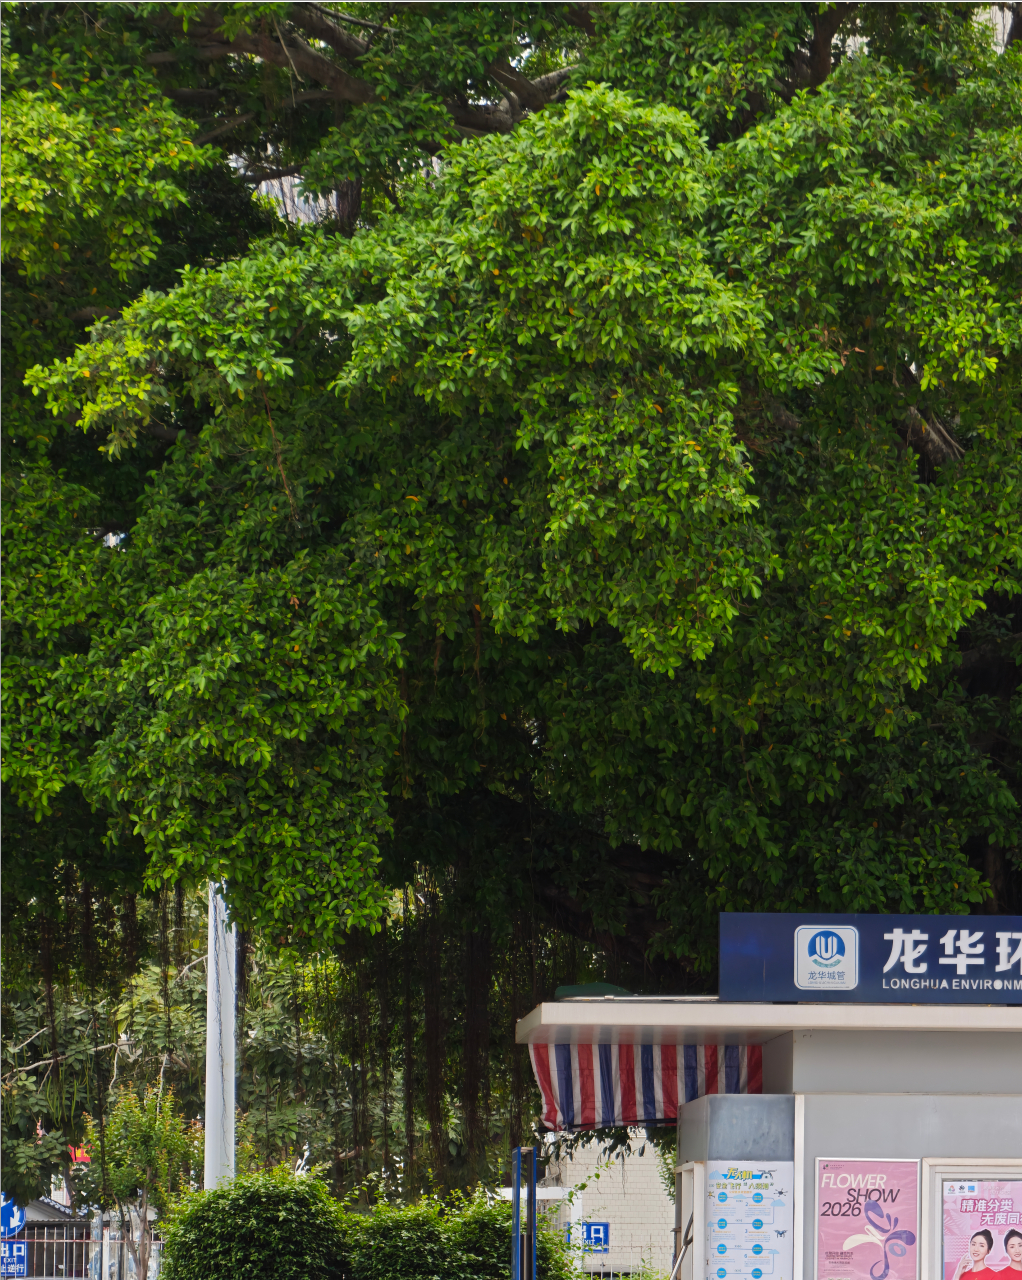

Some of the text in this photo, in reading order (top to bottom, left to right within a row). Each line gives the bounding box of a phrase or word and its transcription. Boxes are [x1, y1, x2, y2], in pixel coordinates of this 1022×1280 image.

[807, 970, 846, 981] 龙华城管
[882, 978, 949, 990] LONGHUA
[726, 1167, 753, 1181] 无人机
[821, 1173, 887, 1189] FLOWER
[846, 1188, 900, 1203] SHOW
[820, 1201, 862, 1217] 2026
[961, 1199, 1013, 1212] 精准分类
[1, 1243, 25, 1257] 出口
